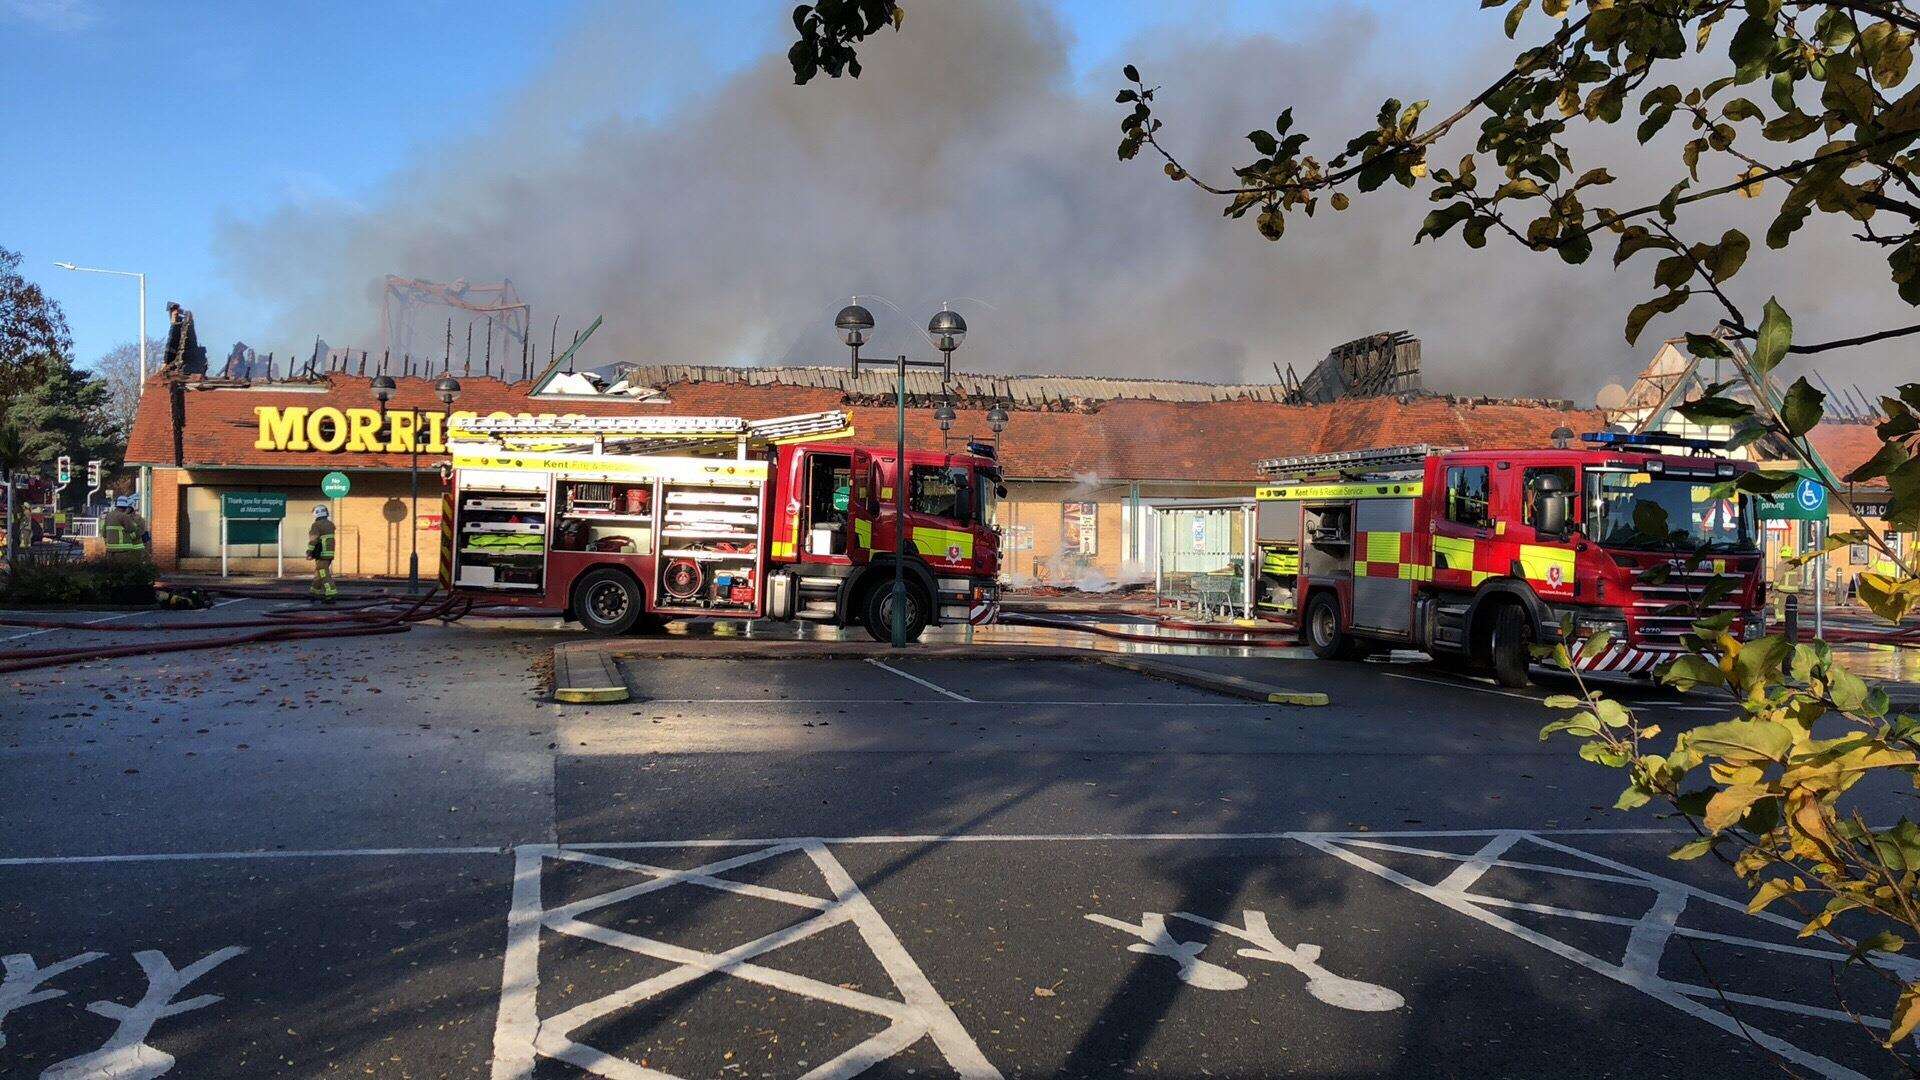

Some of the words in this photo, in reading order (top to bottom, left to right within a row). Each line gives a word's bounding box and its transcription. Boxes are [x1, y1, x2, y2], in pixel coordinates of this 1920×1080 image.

[254, 406, 586, 453] MORRI
[543, 459, 569, 469] Kent
[1295, 487, 1308, 496] Kent
[1344, 486, 1364, 496] Service
[1855, 505, 1865, 515] 24
